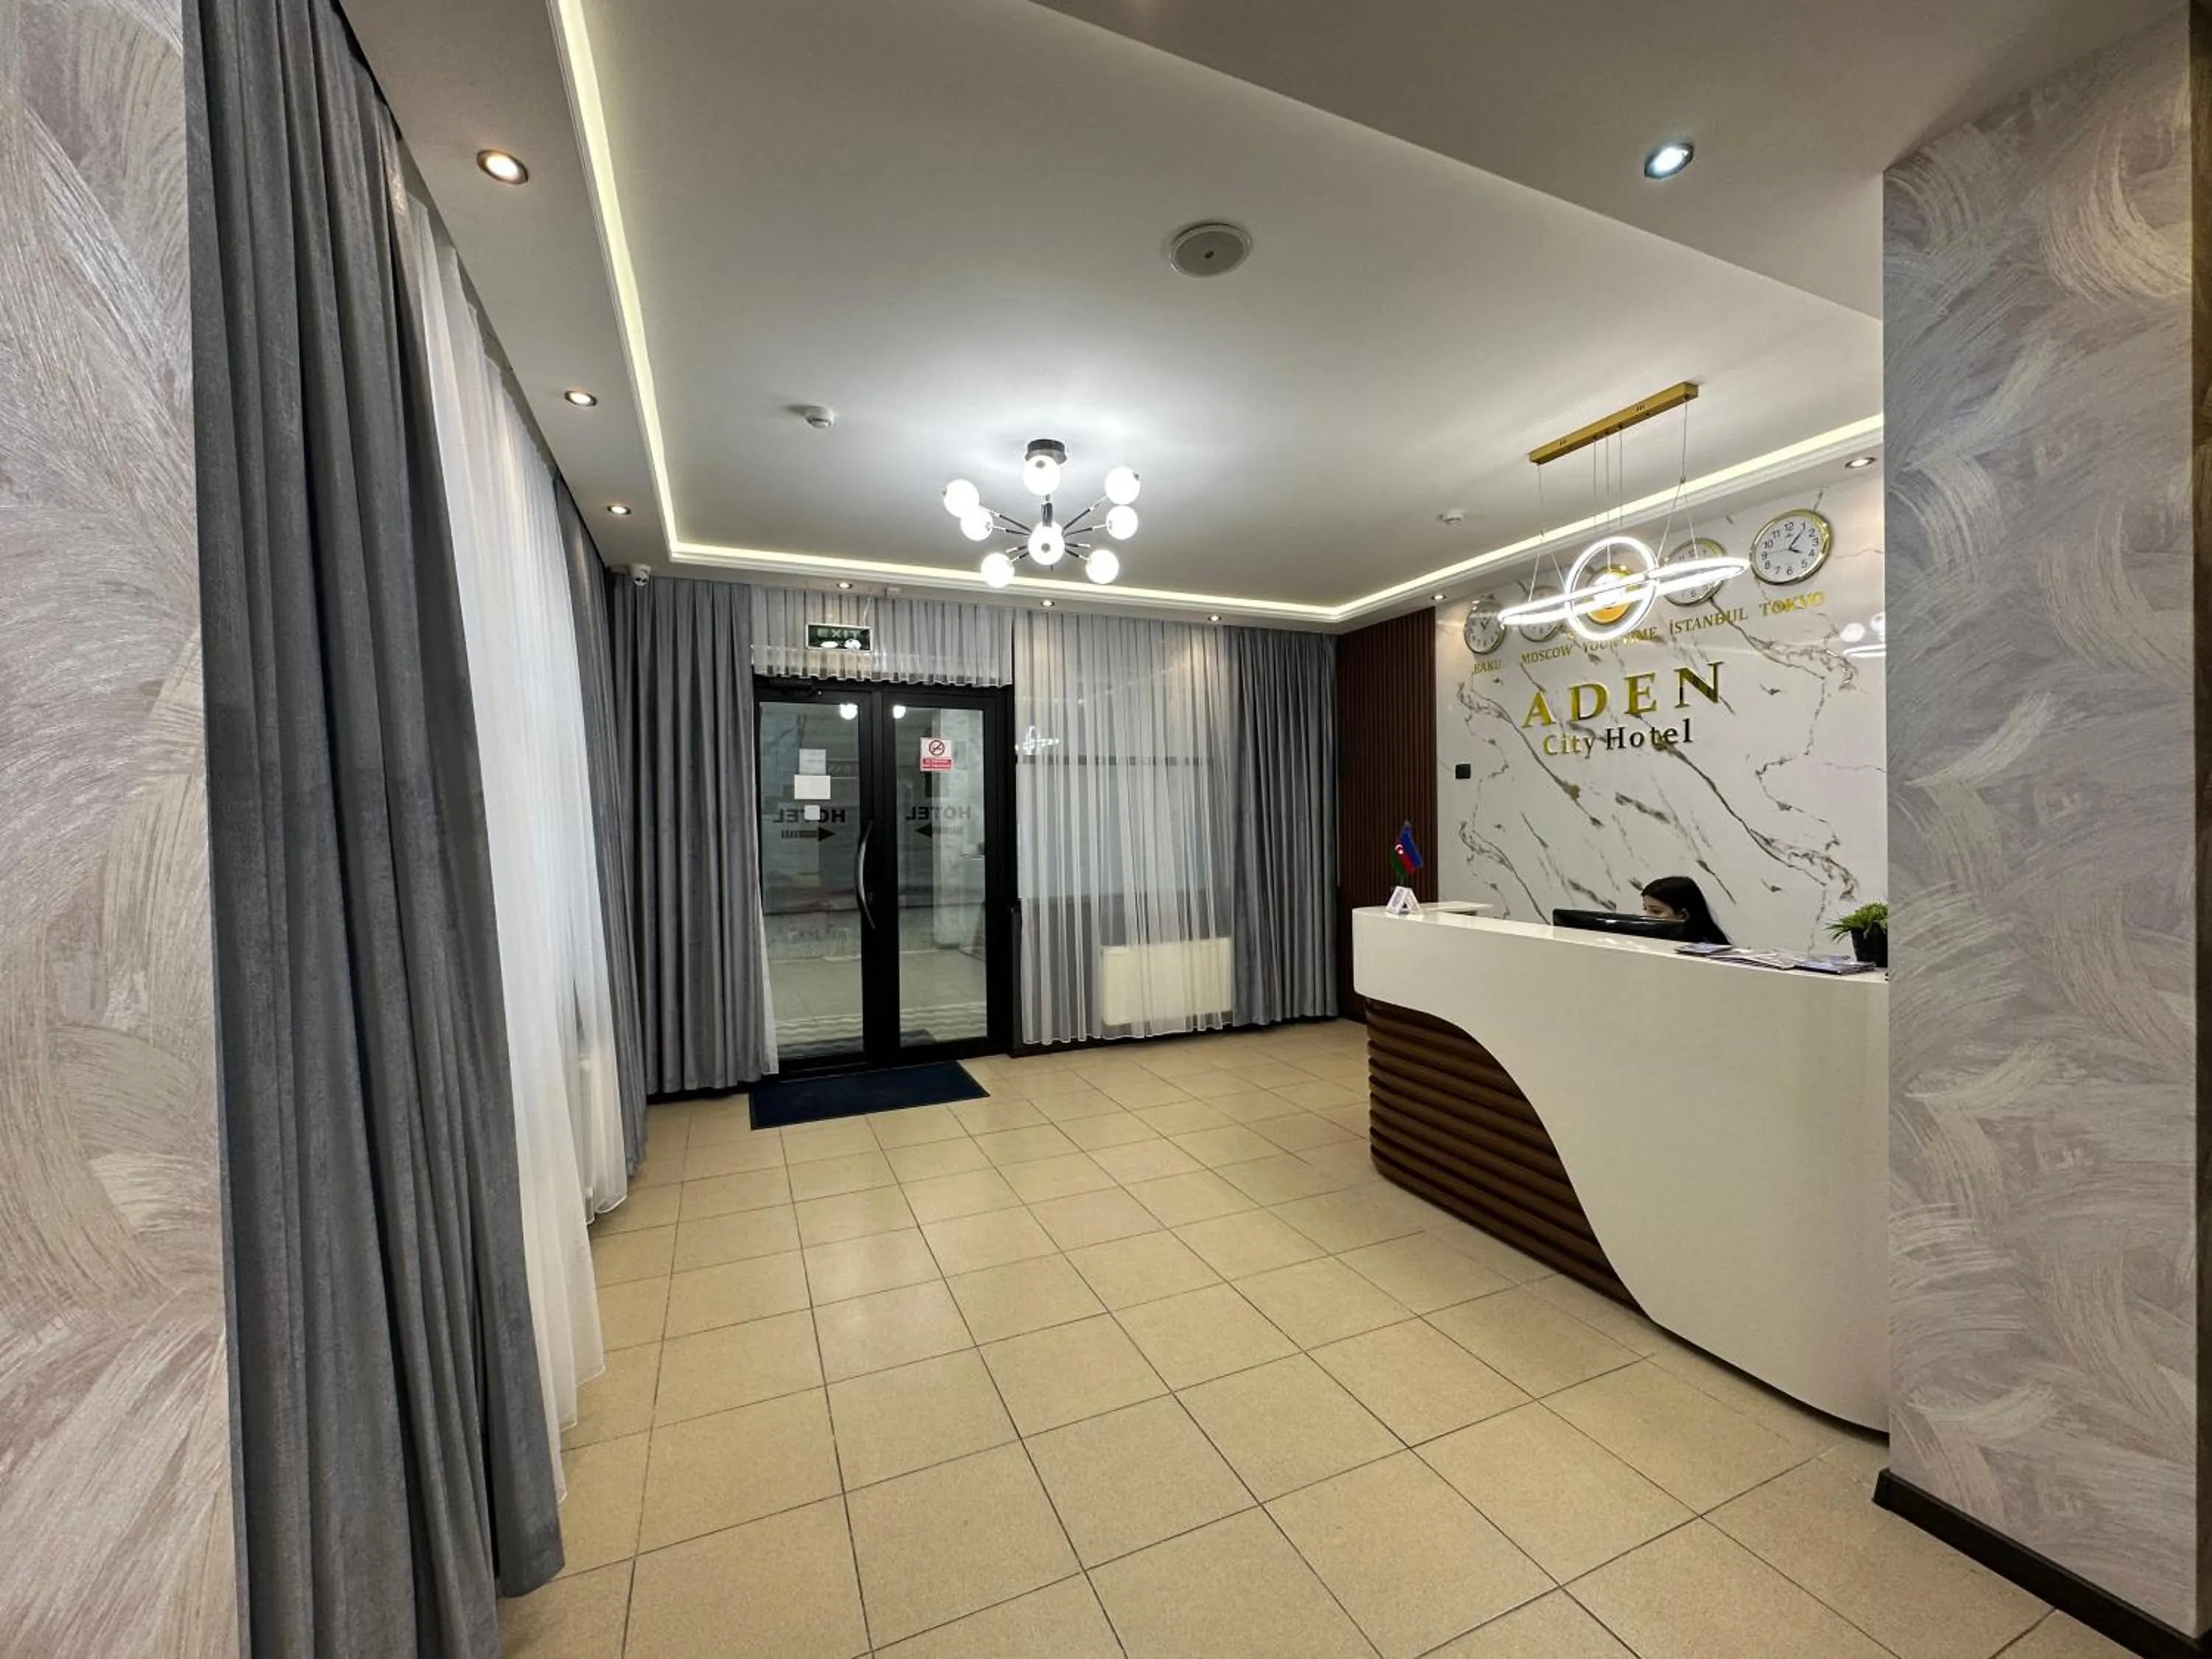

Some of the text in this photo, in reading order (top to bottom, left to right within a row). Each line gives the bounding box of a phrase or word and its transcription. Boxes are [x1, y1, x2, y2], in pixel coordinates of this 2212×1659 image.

[1784, 521, 1794, 532] 12
[1801, 521, 1806, 531] 1
[1772, 529, 1781, 539] 11
[1809, 527, 1815, 538] 2
[1764, 539, 1773, 549] 10
[1812, 538, 1819, 546] 3
[1761, 551, 1768, 561] 9
[1808, 549, 1815, 557] 4
[1764, 560, 1770, 570] 8
[1801, 559, 1808, 568] 5
[1774, 566, 1781, 575] 7
[1787, 566, 1794, 575] 6
[1759, 591, 1825, 616] TOKYO
[817, 627, 861, 639] EXIT
[1520, 644, 1573, 664] MOSCOW
[1474, 660, 1501, 674] BAKU
[1522, 661, 1725, 728] ADEN
[1543, 717, 1694, 759] City Hotel
